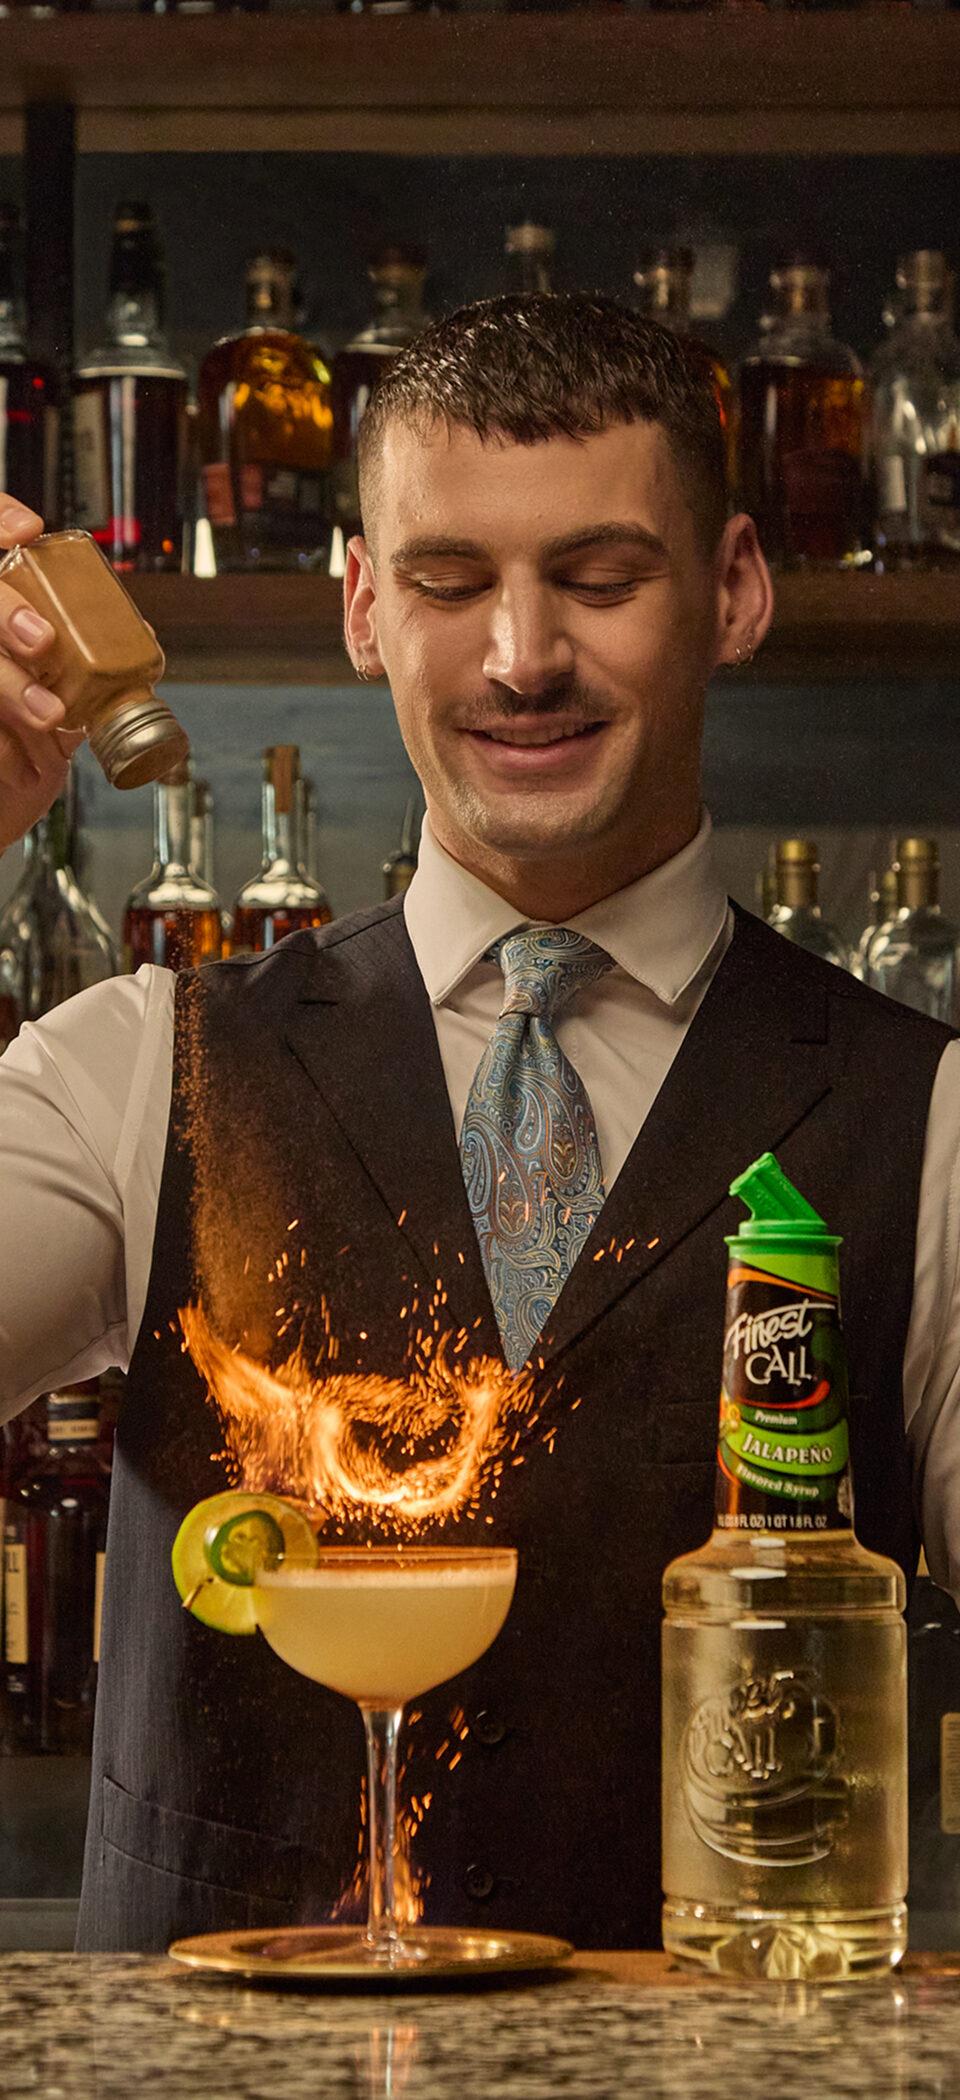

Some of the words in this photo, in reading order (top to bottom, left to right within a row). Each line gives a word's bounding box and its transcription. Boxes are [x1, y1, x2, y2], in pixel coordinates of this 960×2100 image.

[724, 1298, 836, 1360] Finest
[745, 1345, 812, 1386] CALL
[754, 1410, 798, 1426] Premium
[742, 1433, 833, 1464] JALAPEÑO
[736, 1464, 783, 1492] Flavored
[783, 1481, 819, 1498] Syrup
[773, 1514, 788, 1528] QT
[803, 1514, 814, 1528] FL
[814, 1514, 828, 1528] OZ
